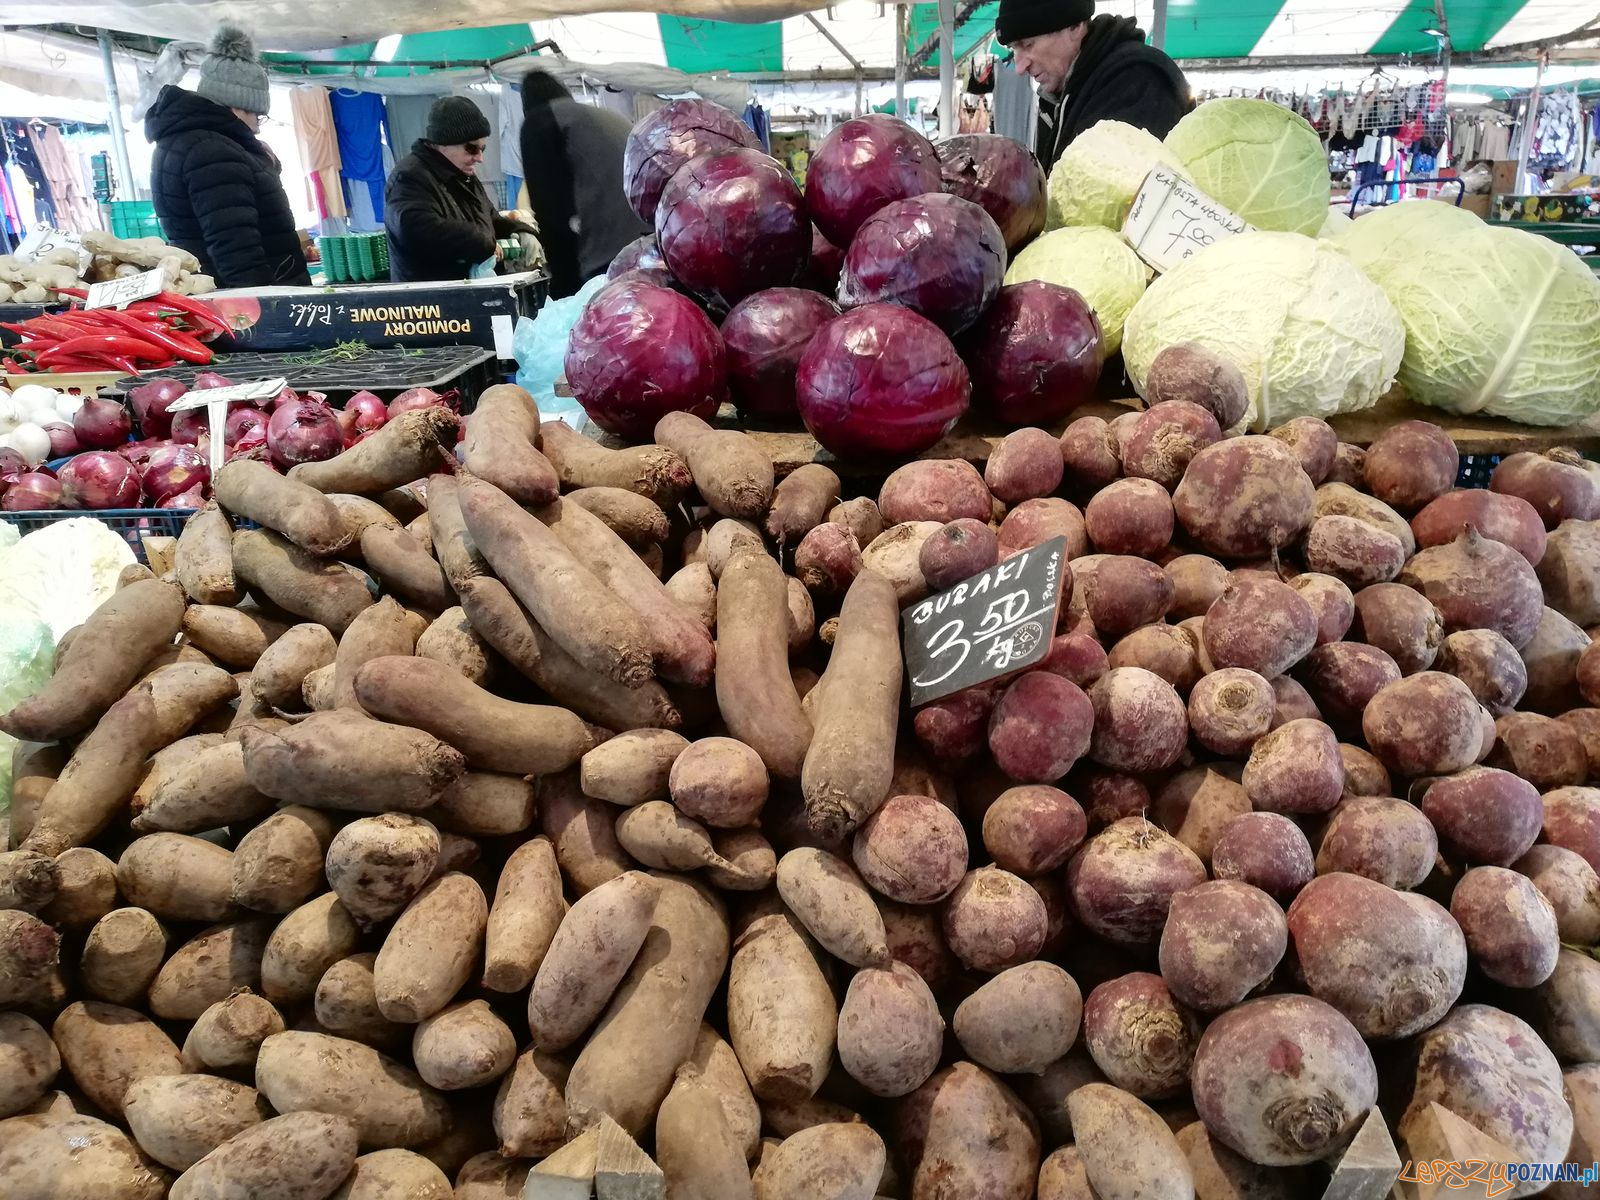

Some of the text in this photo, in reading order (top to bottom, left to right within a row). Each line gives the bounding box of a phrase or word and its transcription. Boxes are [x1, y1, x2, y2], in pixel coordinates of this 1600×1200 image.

[350, 304, 441, 323] MALINOWE
[383, 318, 471, 337] POMIDORY
[911, 553, 1030, 625] BURAKI
[912, 619, 972, 688] 3
[972, 588, 1030, 637] 50
[981, 635, 1014, 669] kg
